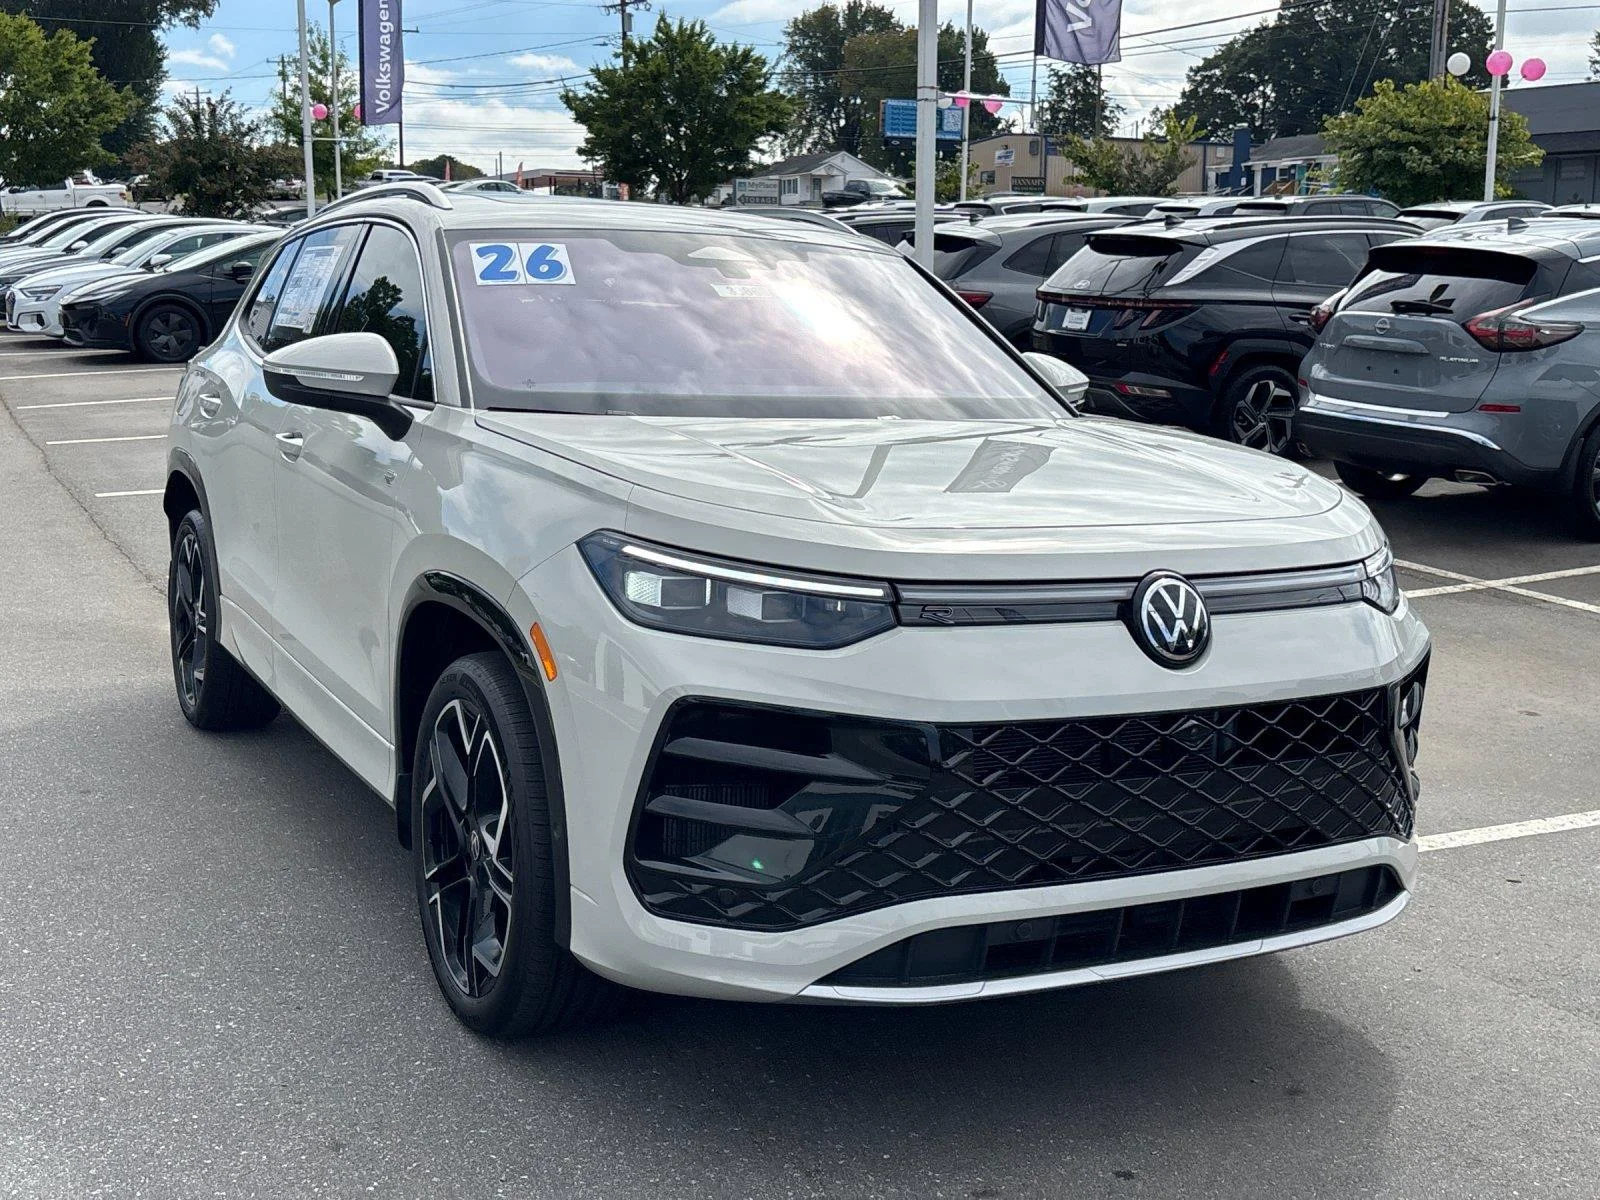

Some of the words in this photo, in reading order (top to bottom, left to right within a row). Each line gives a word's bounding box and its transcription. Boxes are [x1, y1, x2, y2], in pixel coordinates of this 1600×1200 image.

[375, 0, 394, 114] Volkswagen
[740, 196, 778, 204] STORAGE
[475, 244, 568, 282] 26
